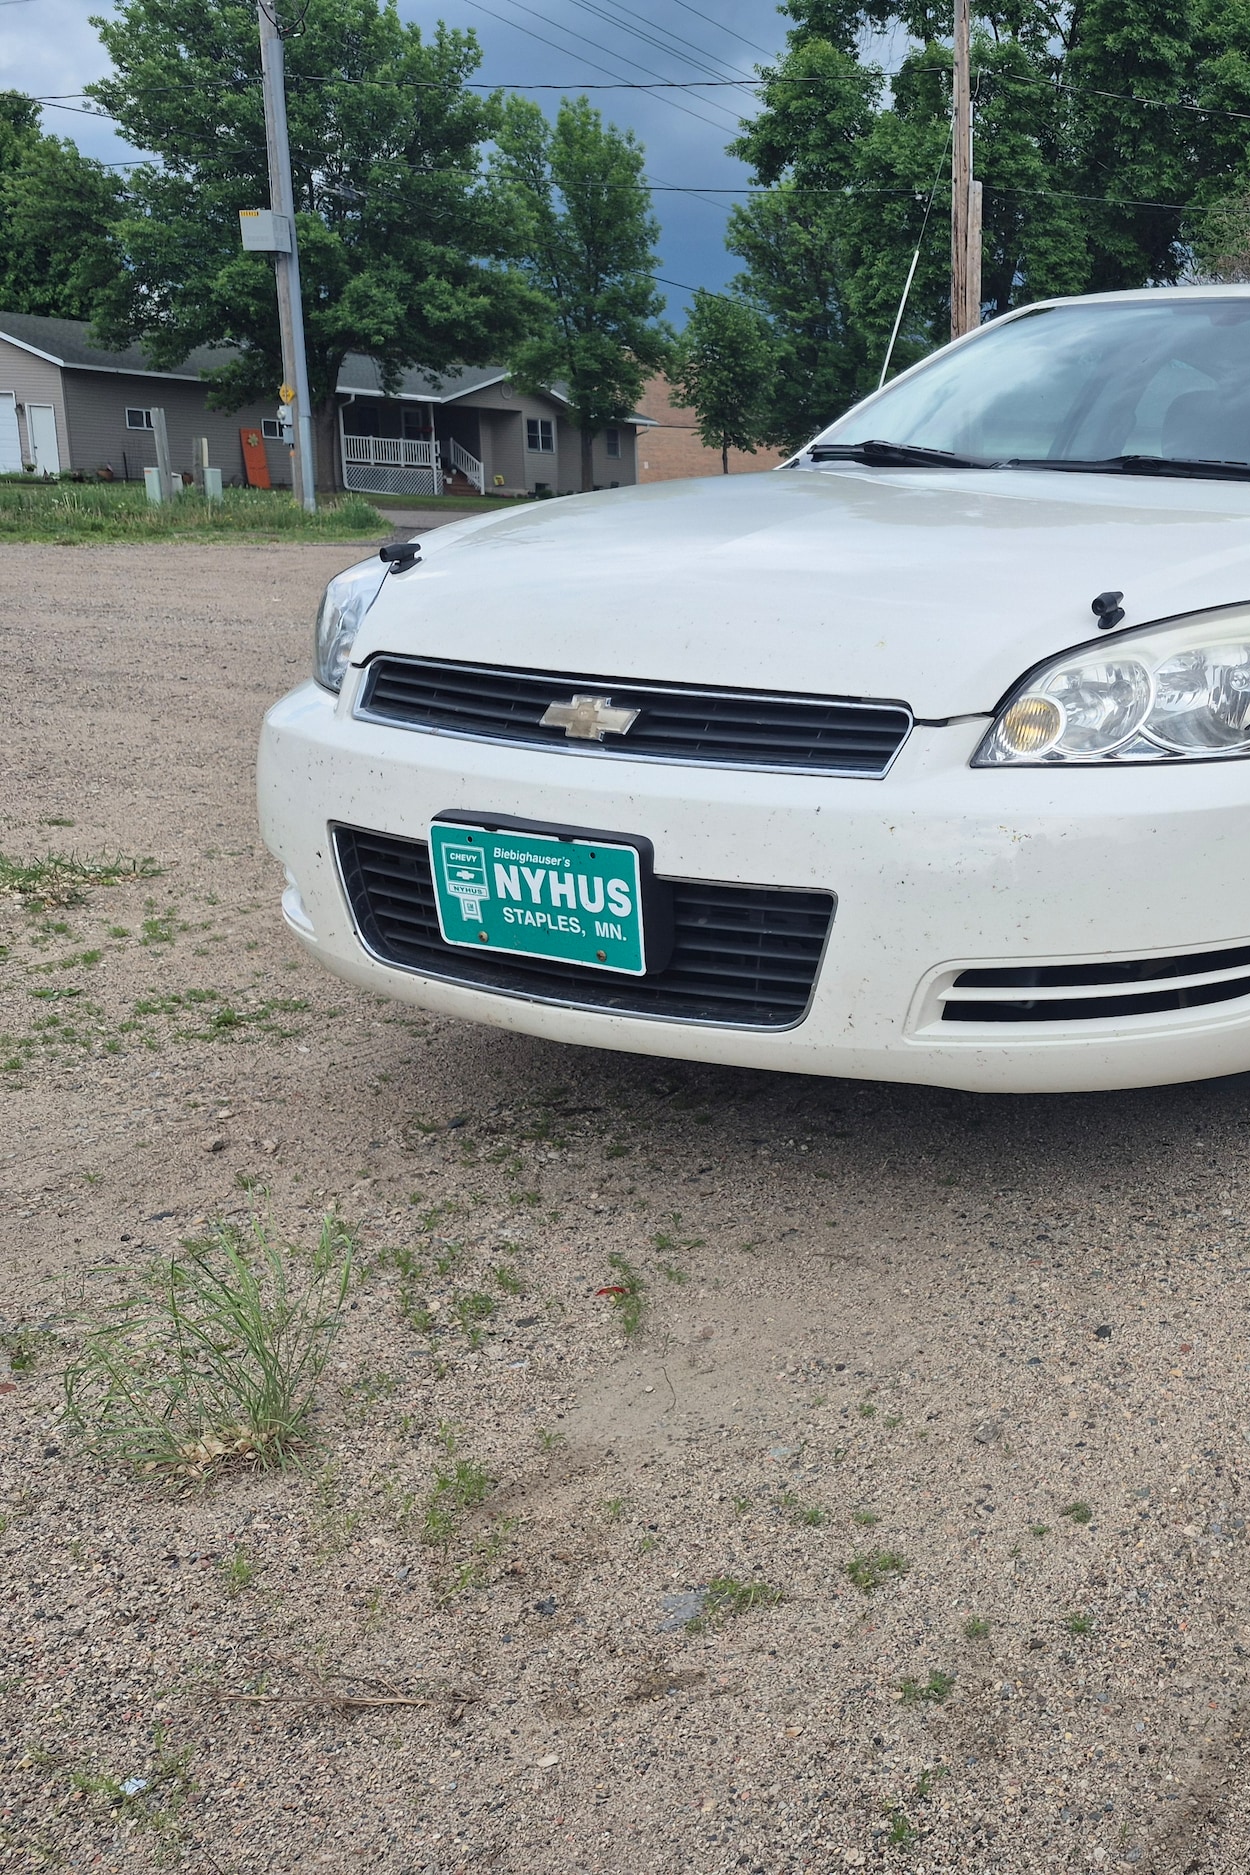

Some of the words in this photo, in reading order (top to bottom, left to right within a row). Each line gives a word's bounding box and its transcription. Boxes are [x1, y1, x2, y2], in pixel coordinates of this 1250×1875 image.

[449, 852, 477, 863] CHEVY
[493, 847, 571, 867] Biebighauser's
[453, 885, 483, 895] NYHUS
[494, 863, 632, 917] NYHUS
[503, 907, 587, 937] STAPLES,
[595, 921, 627, 941] MN.
